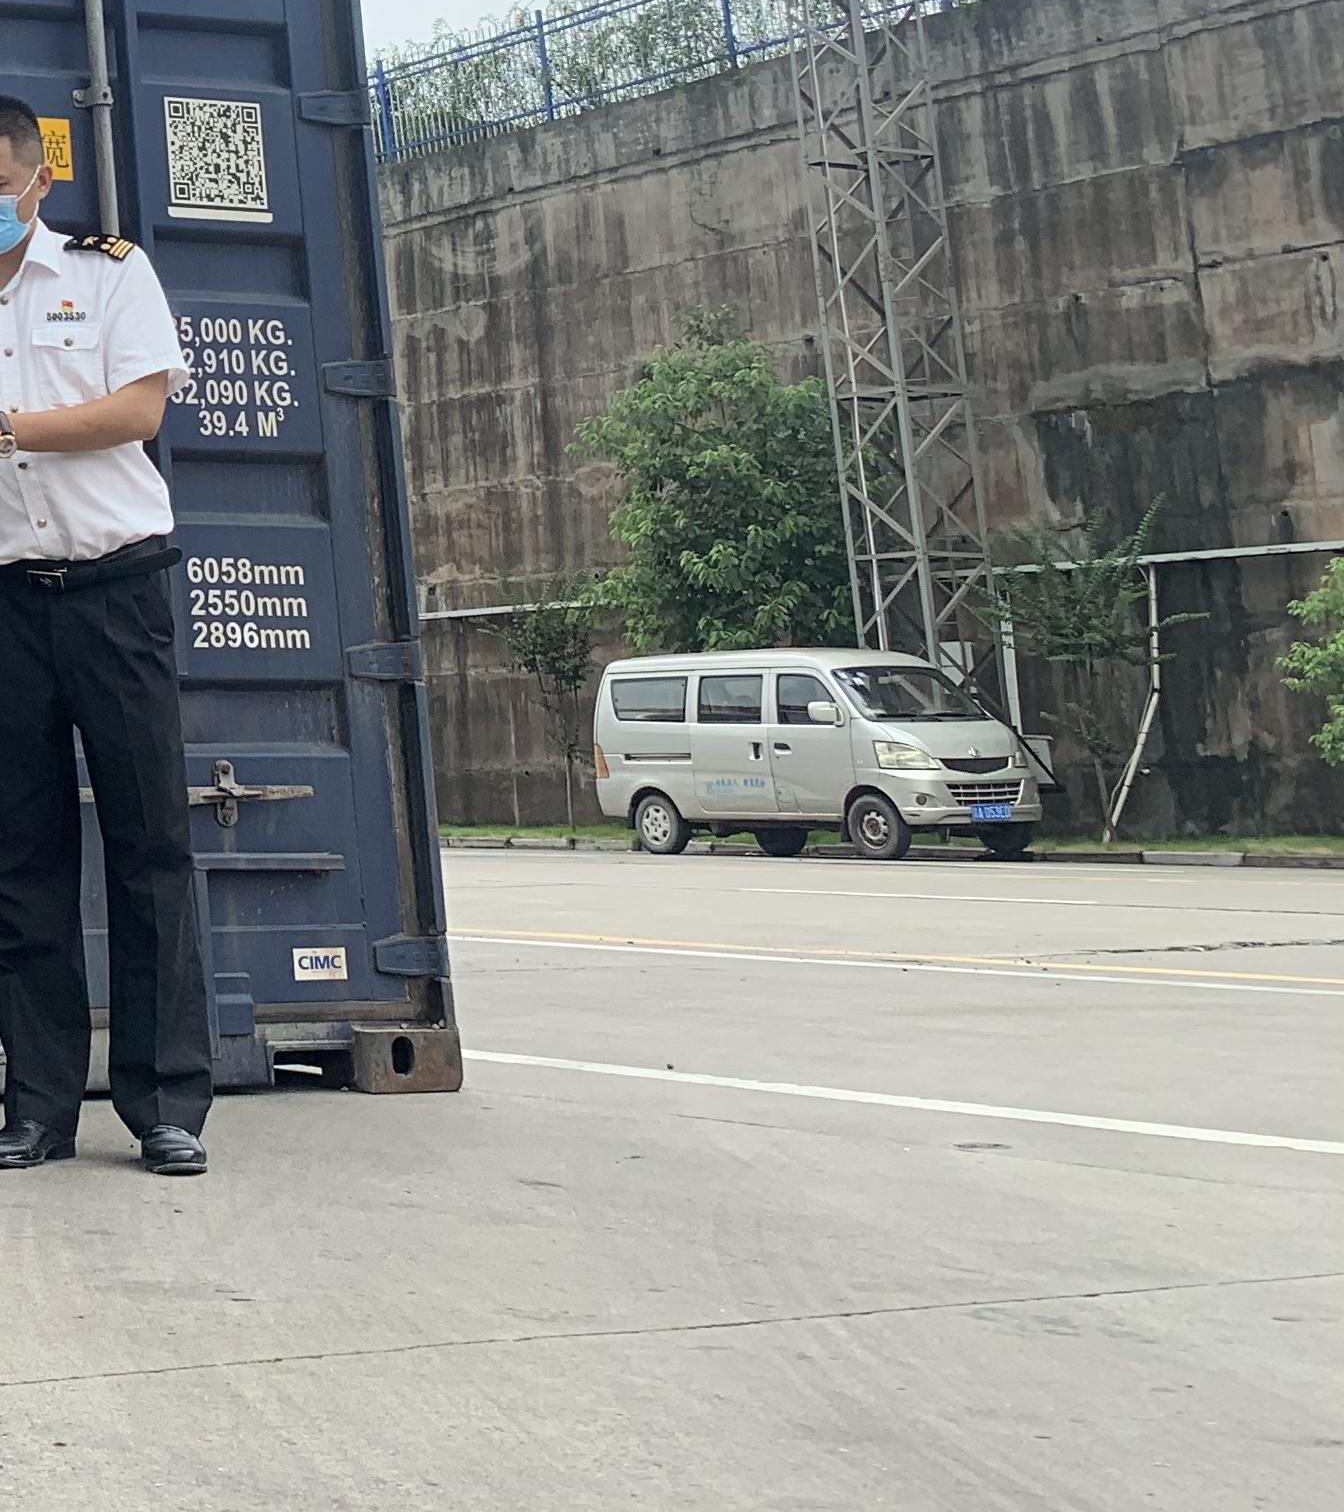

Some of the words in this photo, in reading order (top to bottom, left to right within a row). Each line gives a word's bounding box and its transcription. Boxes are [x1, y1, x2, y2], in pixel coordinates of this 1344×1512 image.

[179, 316, 243, 346] 5,000
[247, 318, 293, 346] KG.
[250, 349, 296, 376] KG.
[253, 380, 299, 407] KG.
[198, 410, 250, 437] 39.4
[186, 557, 305, 585] 6058mm
[189, 589, 308, 617] 2550mm
[192, 621, 311, 649] 2896mm
[298, 955, 342, 970] CIMC
